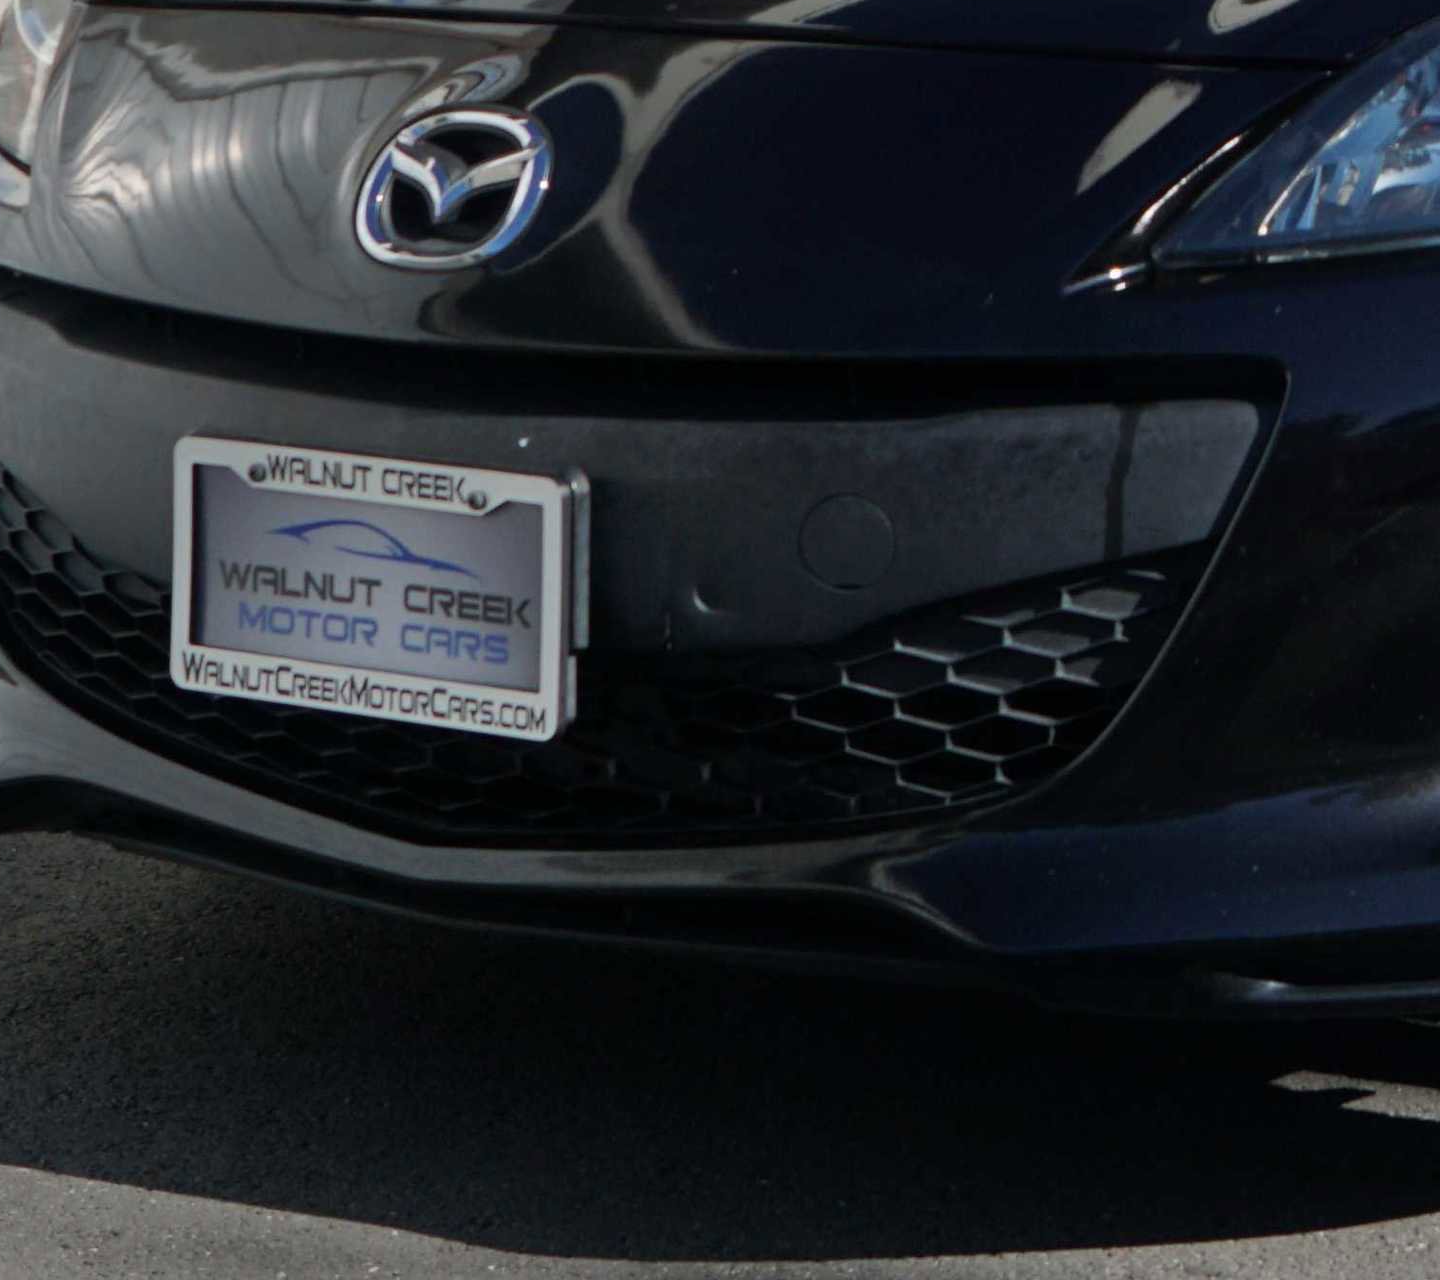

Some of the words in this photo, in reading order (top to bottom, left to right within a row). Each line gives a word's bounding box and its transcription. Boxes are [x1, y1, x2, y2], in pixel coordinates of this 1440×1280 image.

[267, 453, 371, 492] WALNUT
[381, 469, 465, 503] CREEK
[219, 560, 381, 607] WALNUT
[403, 583, 532, 629] CREEK
[237, 601, 379, 647] MOTOR
[399, 622, 510, 665] CARS
